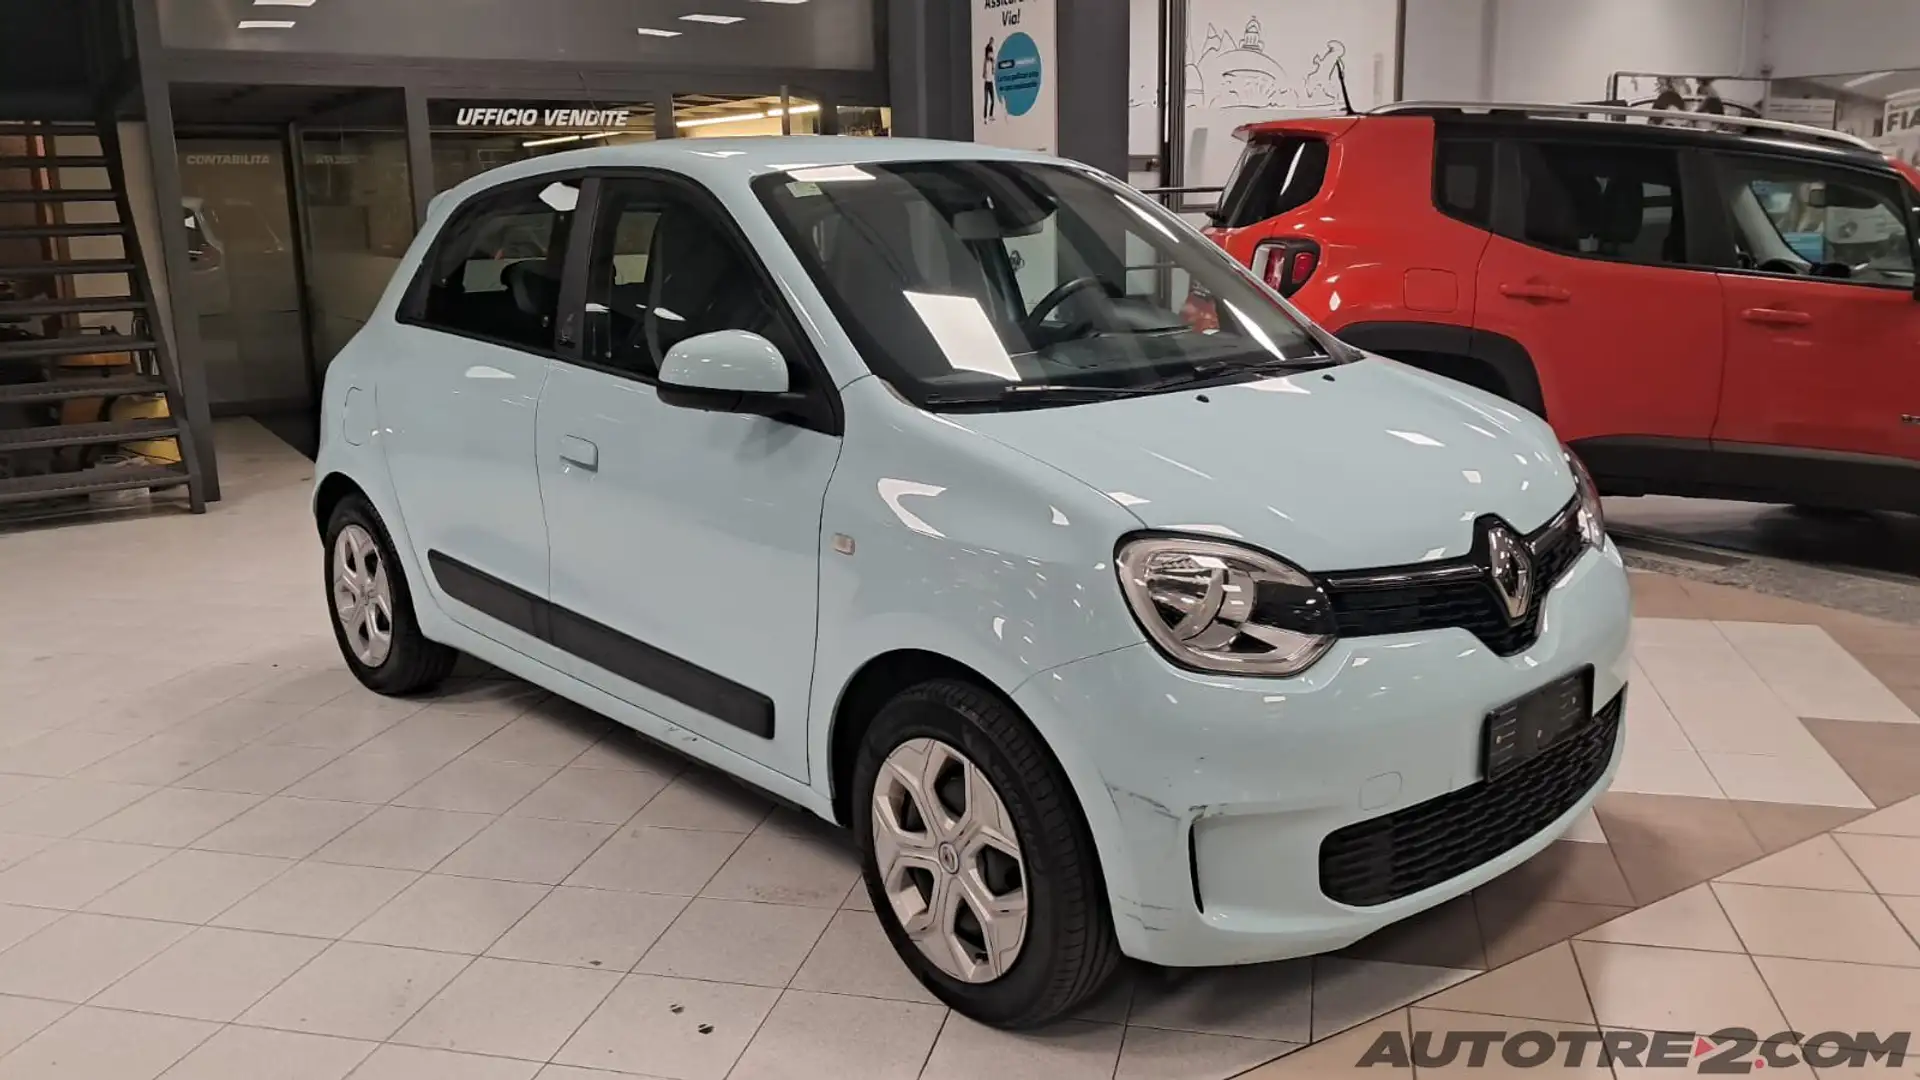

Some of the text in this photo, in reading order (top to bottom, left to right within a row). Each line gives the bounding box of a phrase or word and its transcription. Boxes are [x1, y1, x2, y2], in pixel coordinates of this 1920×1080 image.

[1001, 8, 1021, 27] Via!
[456, 107, 630, 127] UFFICIO VENDITE
